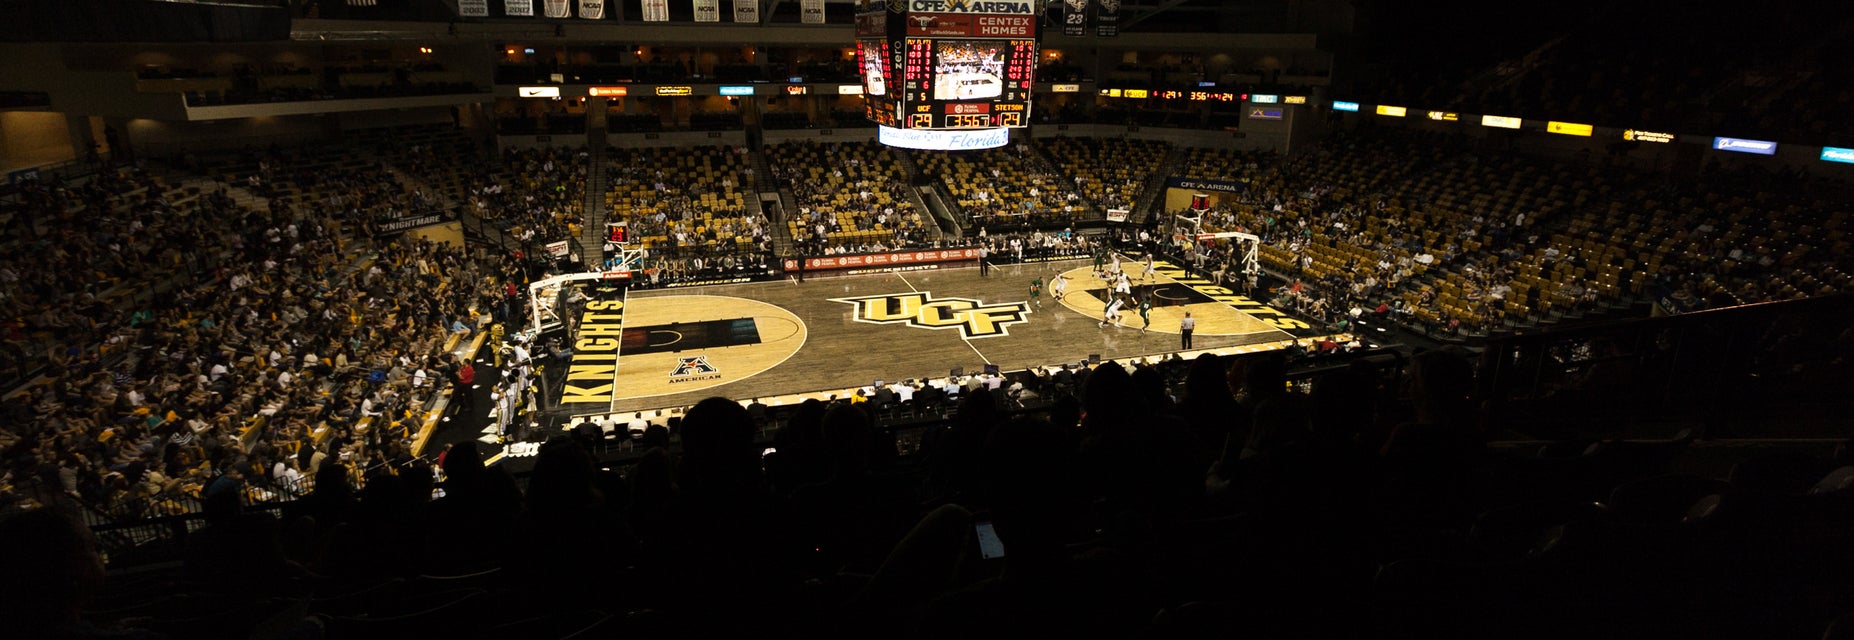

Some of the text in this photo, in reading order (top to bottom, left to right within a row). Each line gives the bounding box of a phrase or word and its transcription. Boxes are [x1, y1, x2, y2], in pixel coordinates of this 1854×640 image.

[912, 0, 1030, 14] CFE ARENA
[979, 17, 1030, 26] CENTEX
[1066, 14, 1084, 24] 23
[982, 26, 1026, 35] HOMES
[894, 40, 902, 70] zero
[923, 81, 929, 89] 6
[1021, 81, 1029, 89] 10
[920, 92, 926, 101] 5
[916, 115, 932, 128] 29
[954, 115, 979, 127] 3:56
[1004, 113, 1019, 126] 24
[948, 134, 1000, 147] Florida
[1206, 183, 1236, 191] ARENA
[845, 292, 1027, 338] UCF
[560, 299, 624, 405] KNIGHTS
[668, 375, 721, 384] AMERICAN
